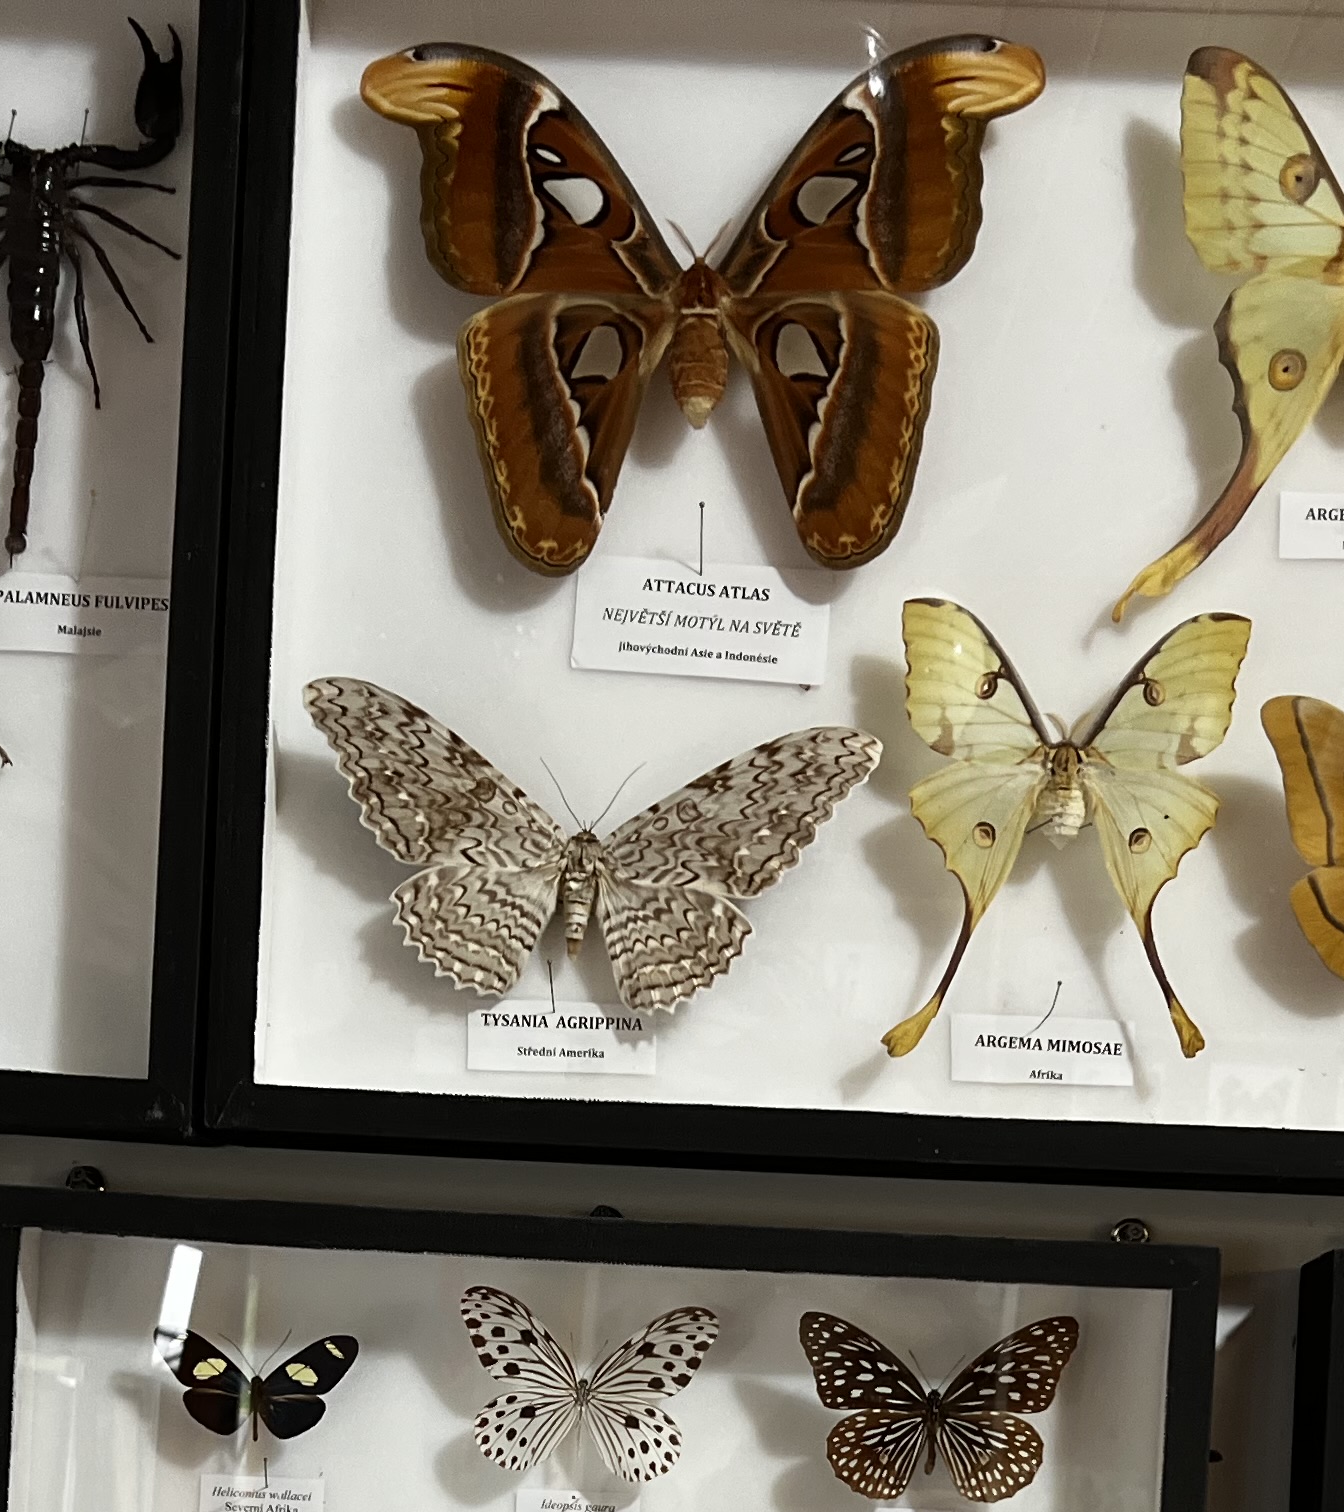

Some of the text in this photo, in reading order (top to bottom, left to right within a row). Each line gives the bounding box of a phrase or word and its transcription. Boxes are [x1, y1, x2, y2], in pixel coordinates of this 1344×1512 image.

[642, 577, 771, 603] ATTACUS ATLAS
[94, 594, 169, 612] FULVIPES
[57, 624, 102, 638] Malajsie
[602, 606, 802, 638] NEJVĚTŠÍ MOTÝL NA SVĚTĚ
[691, 646, 714, 660] Asie
[716, 651, 723, 660] a
[725, 648, 779, 665] Indonésie
[480, 1013, 643, 1033] TYSANIA AGRIPPINA
[516, 1045, 605, 1059] Střední Amerika
[974, 1034, 1123, 1057] ARGEMA MIMOSAE
[1029, 1069, 1063, 1082] Afrika
[212, 1486, 267, 1501] Heliconius
[541, 1498, 582, 1512] Ideopsis
